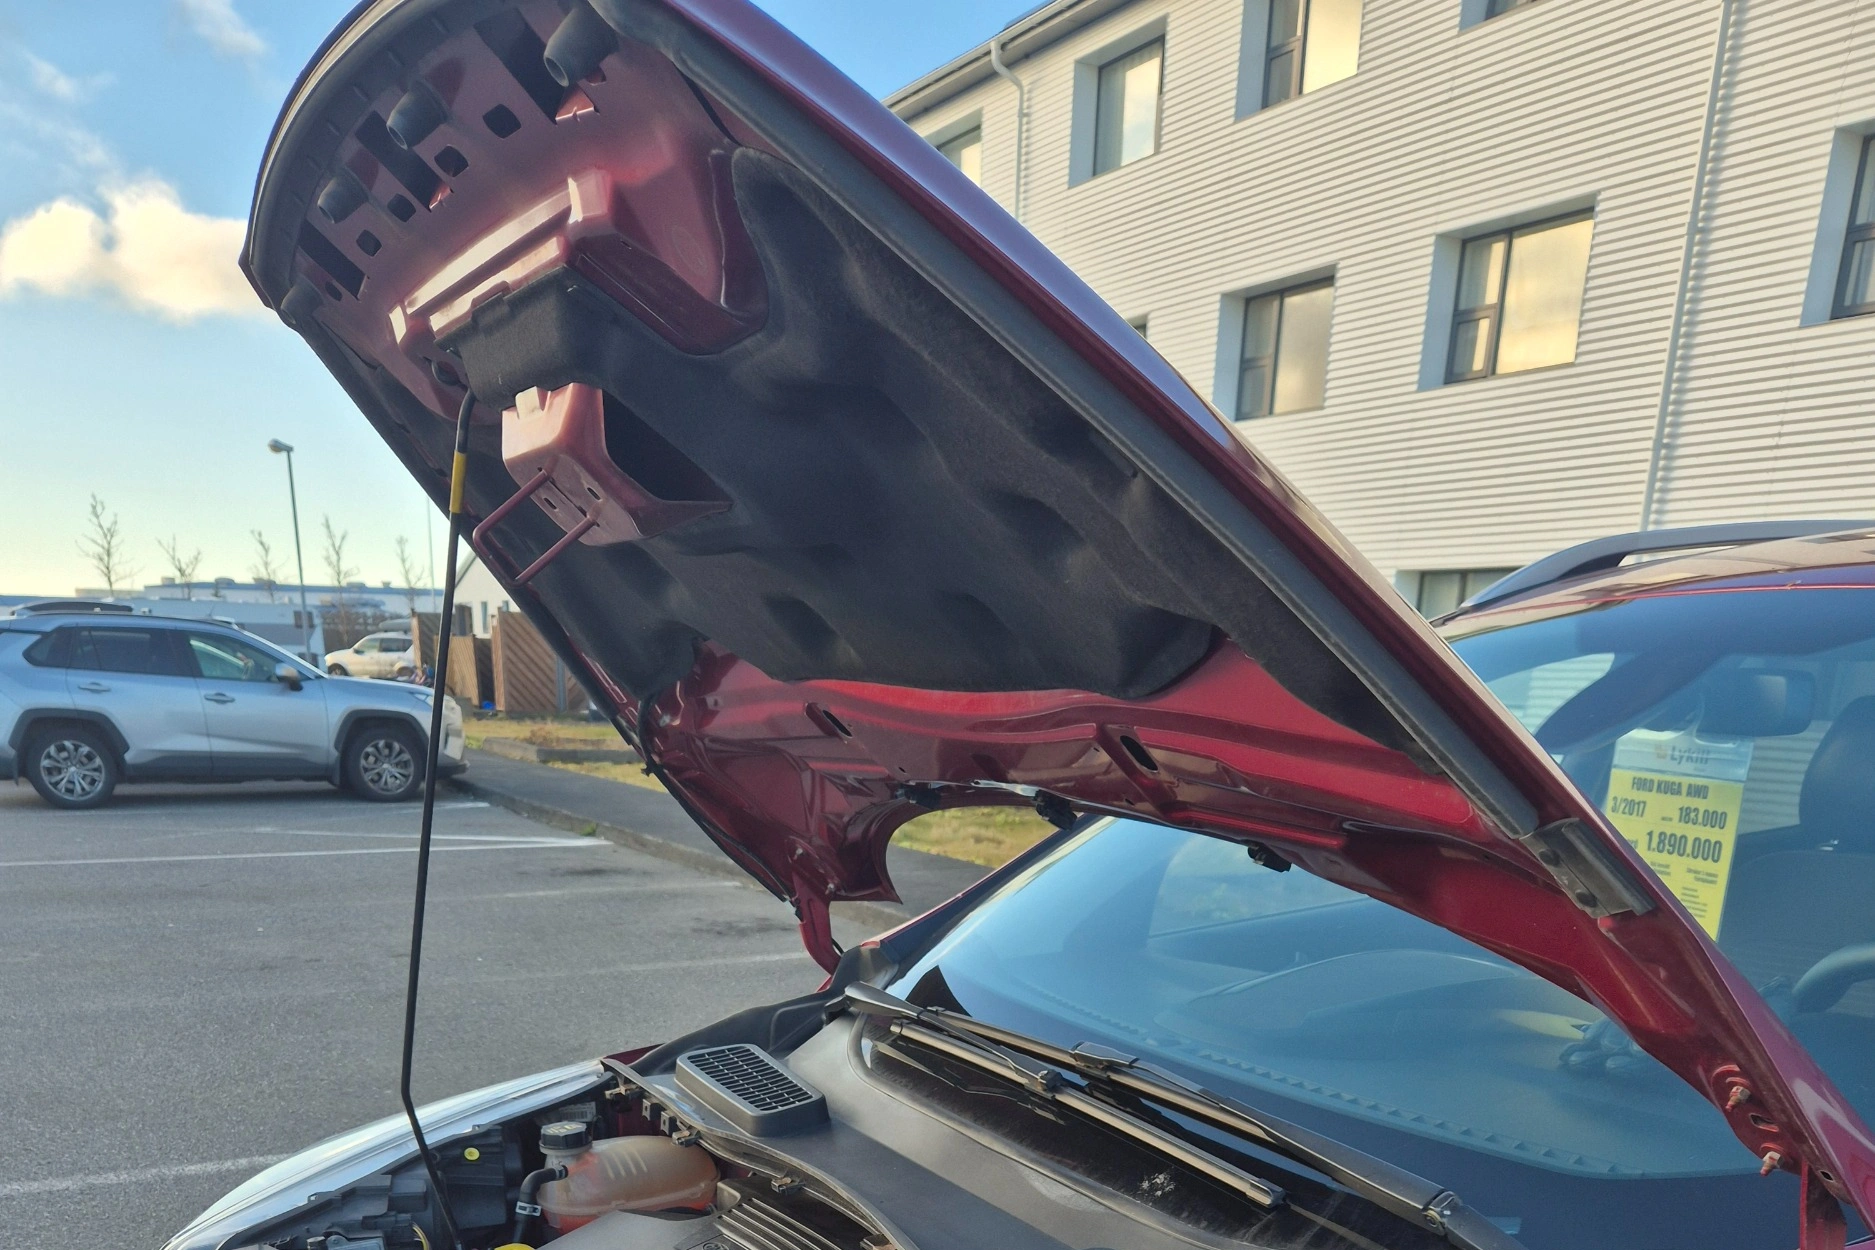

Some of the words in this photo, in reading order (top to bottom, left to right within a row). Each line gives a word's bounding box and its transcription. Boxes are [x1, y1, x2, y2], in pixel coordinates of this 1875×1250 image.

[1632, 776, 1655, 793] FORD
[1656, 779, 1682, 796] KUGA
[1686, 783, 1710, 800] AWD
[1611, 796, 1647, 818] 3/2017
[1678, 805, 1728, 830] 183.000
[1646, 830, 1723, 863] 1.890.000
